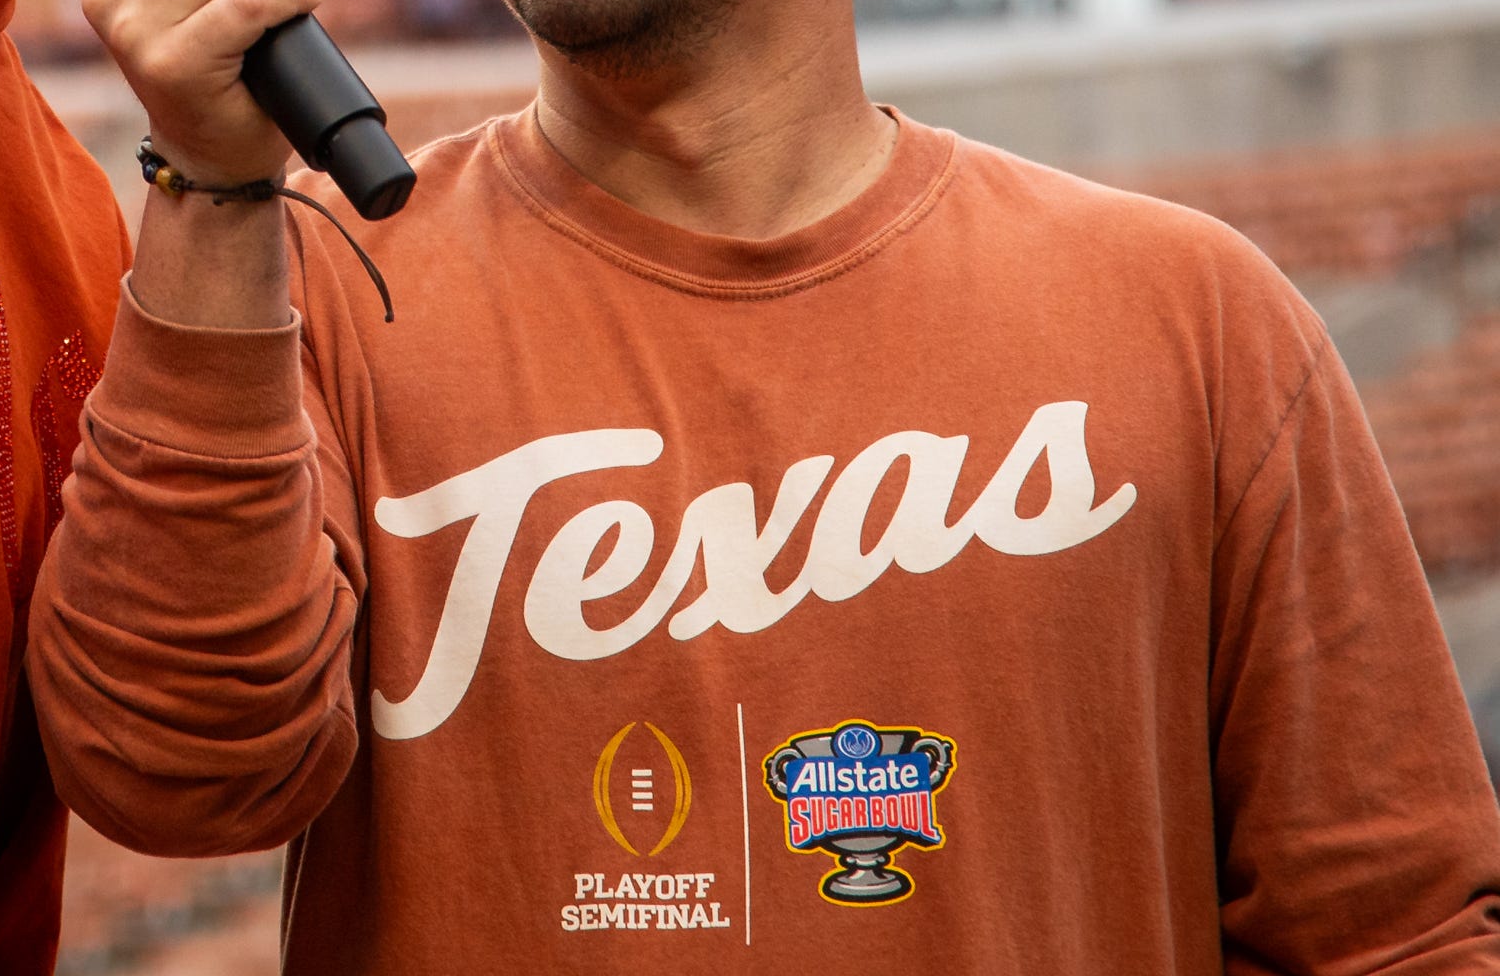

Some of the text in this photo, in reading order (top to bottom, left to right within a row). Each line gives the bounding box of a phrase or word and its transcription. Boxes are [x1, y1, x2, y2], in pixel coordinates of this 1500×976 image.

[371, 400, 1138, 740] Texas
[790, 760, 919, 793] Allstate
[789, 790, 941, 847] SUGAR BOWL
[573, 872, 715, 901] PLAYOFF
[560, 901, 731, 932] SEMIFINAL
